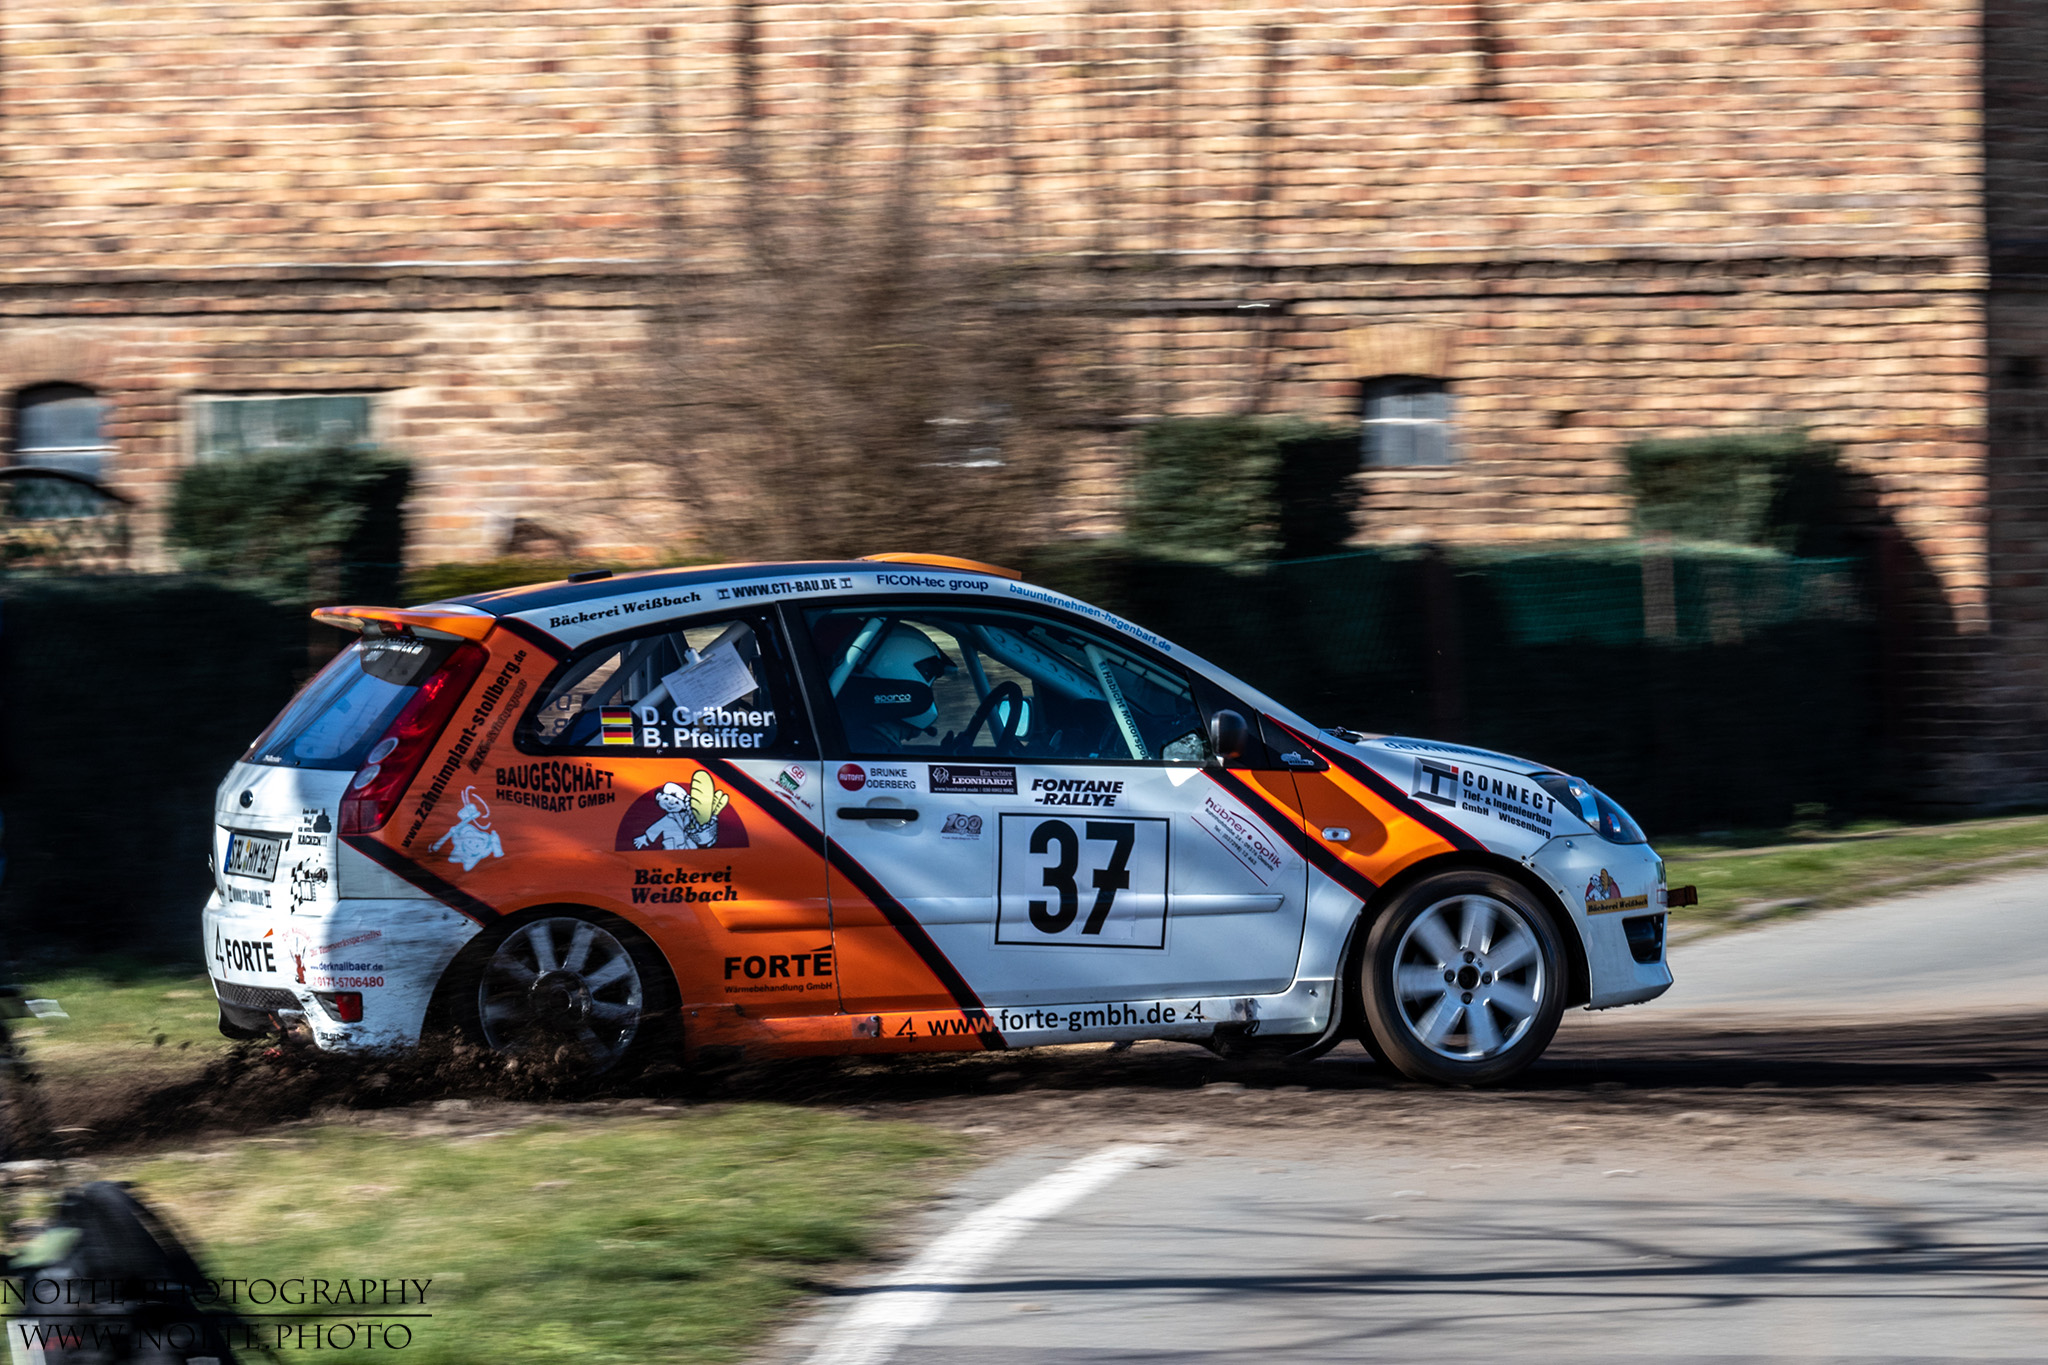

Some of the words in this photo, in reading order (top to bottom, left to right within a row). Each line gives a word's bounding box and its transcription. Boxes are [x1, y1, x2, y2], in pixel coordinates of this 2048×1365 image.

[876, 574, 945, 588] FICON-tec
[949, 579, 989, 592] group
[549, 605, 620, 628] Bäckerei
[622, 591, 702, 613] Weißbach
[1009, 583, 1172, 652] bauunternehmen-hegenbart.de
[1103, 671, 1125, 708] Habicht
[641, 706, 667, 726] D.
[672, 706, 774, 728] Gräbner
[643, 727, 669, 748] B.
[674, 726, 763, 748] Pfeiffer
[401, 649, 527, 849] www.zahnimplant-stollberg.de
[496, 761, 614, 794] BAUGESCHÄFT
[791, 766, 805, 779] GB
[870, 768, 908, 777] BRUNKE
[952, 777, 1014, 785] LEONHARDT
[866, 779, 917, 789] ODERBERG
[1031, 778, 1124, 793] FONTANE
[1463, 770, 1557, 814] CONNECT
[496, 789, 574, 813] HEGENBART
[578, 792, 615, 808] GMBH
[1034, 793, 1117, 807] -RALLYE
[1463, 789, 1483, 802] Tief-
[1485, 796, 1491, 804] &
[1493, 799, 1552, 827] Ingenieurbau
[1462, 802, 1489, 816] GmbH
[1499, 812, 1551, 839] Wiesenburg
[1205, 797, 1247, 835] hübner
[1254, 841, 1281, 868] optik
[634, 866, 732, 885] Bäckerei
[1029, 819, 1135, 935] 37
[631, 886, 738, 904] Weißbach
[1588, 902, 1618, 912] Bäckerei
[317, 976, 384, 987] 0171-5706480
[725, 982, 804, 994] Wärmebehandlung
[806, 981, 833, 991] GmbH
[927, 1002, 1176, 1037] www.forte-gmbh.de
